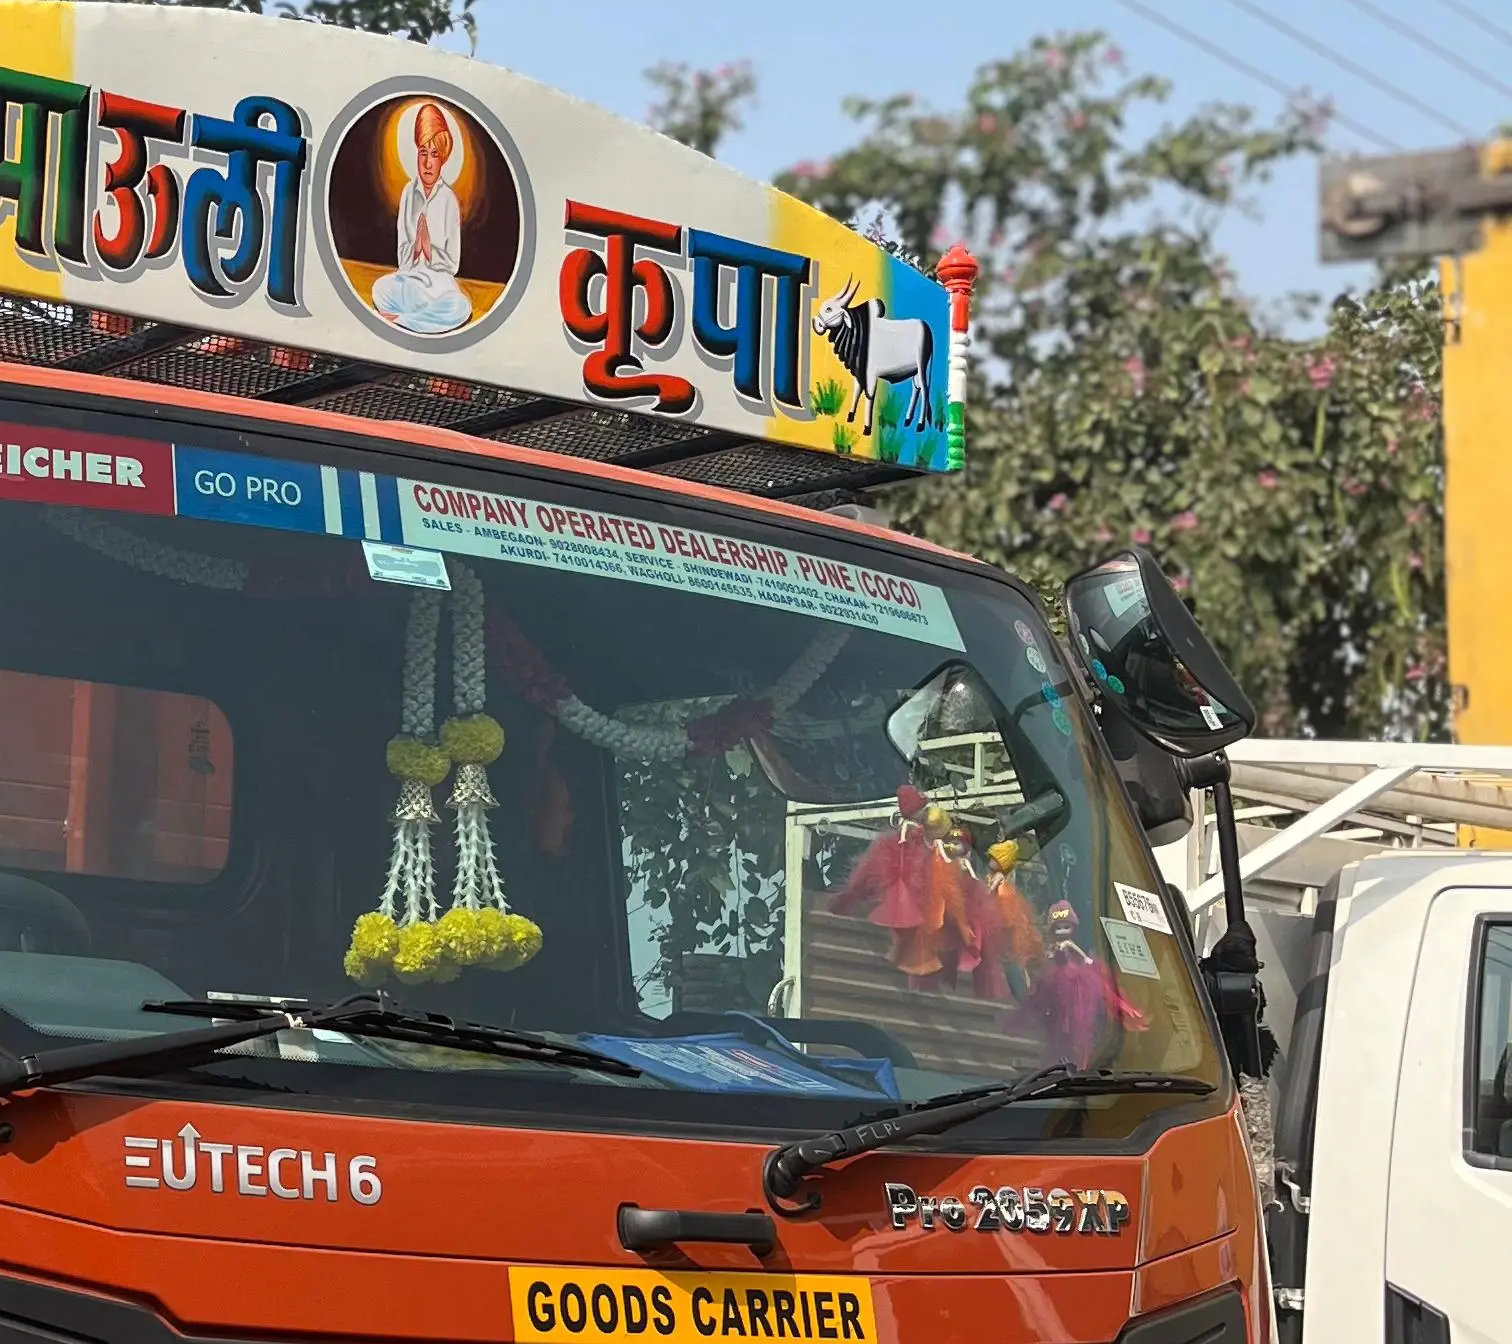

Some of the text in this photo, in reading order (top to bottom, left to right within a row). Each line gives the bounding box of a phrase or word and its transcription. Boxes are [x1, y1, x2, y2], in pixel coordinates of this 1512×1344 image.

[194, 469, 302, 506] GO PRO
[413, 484, 529, 529] COMPANY
[536, 505, 656, 551] OPERATED
[854, 567, 922, 610] (COCO)
[422, 518, 463, 534] SALES
[625, 551, 675, 569] SERVICE
[124, 1122, 383, 1206] EUTECH 6
[527, 1280, 865, 1341] GOODS CARRIER
